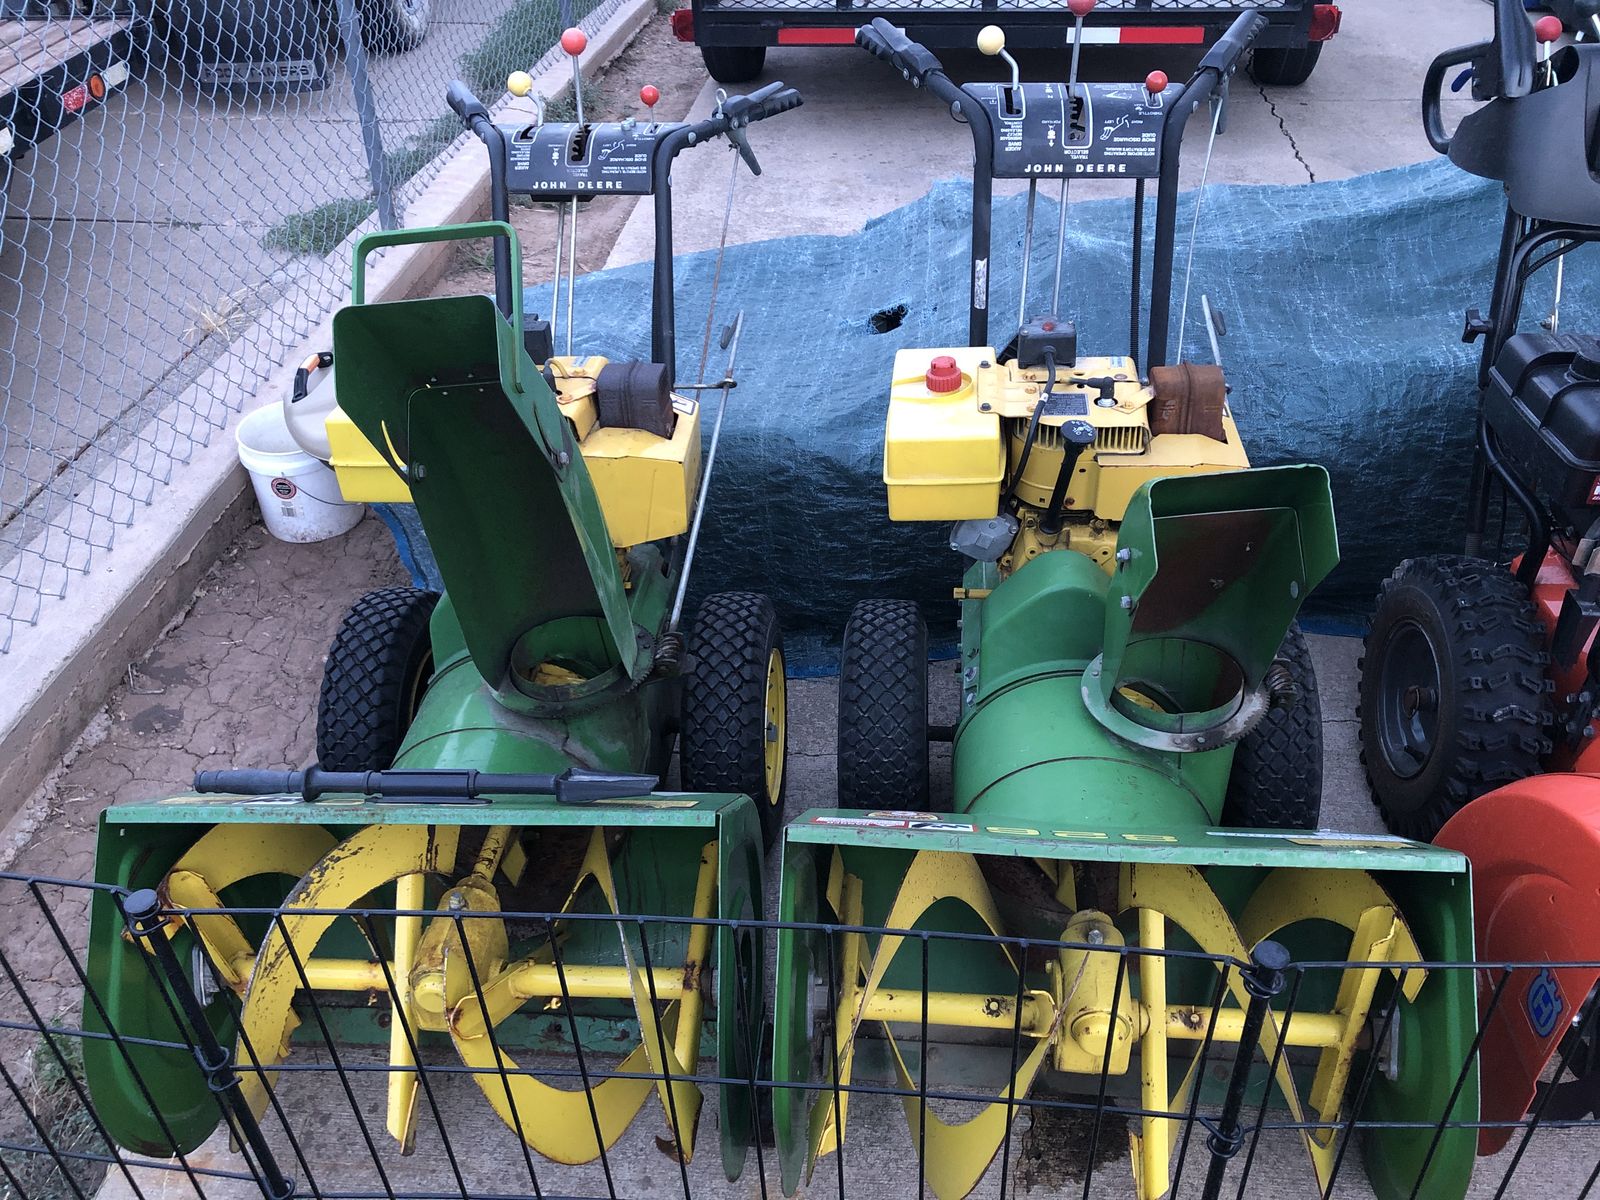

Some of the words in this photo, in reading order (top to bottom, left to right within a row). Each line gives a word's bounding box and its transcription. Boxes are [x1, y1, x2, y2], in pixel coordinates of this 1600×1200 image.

[1024, 164, 1064, 173] JOHN
[1075, 164, 1127, 173] DEERE
[532, 181, 567, 189] JOHN
[577, 181, 623, 189] DEERE
